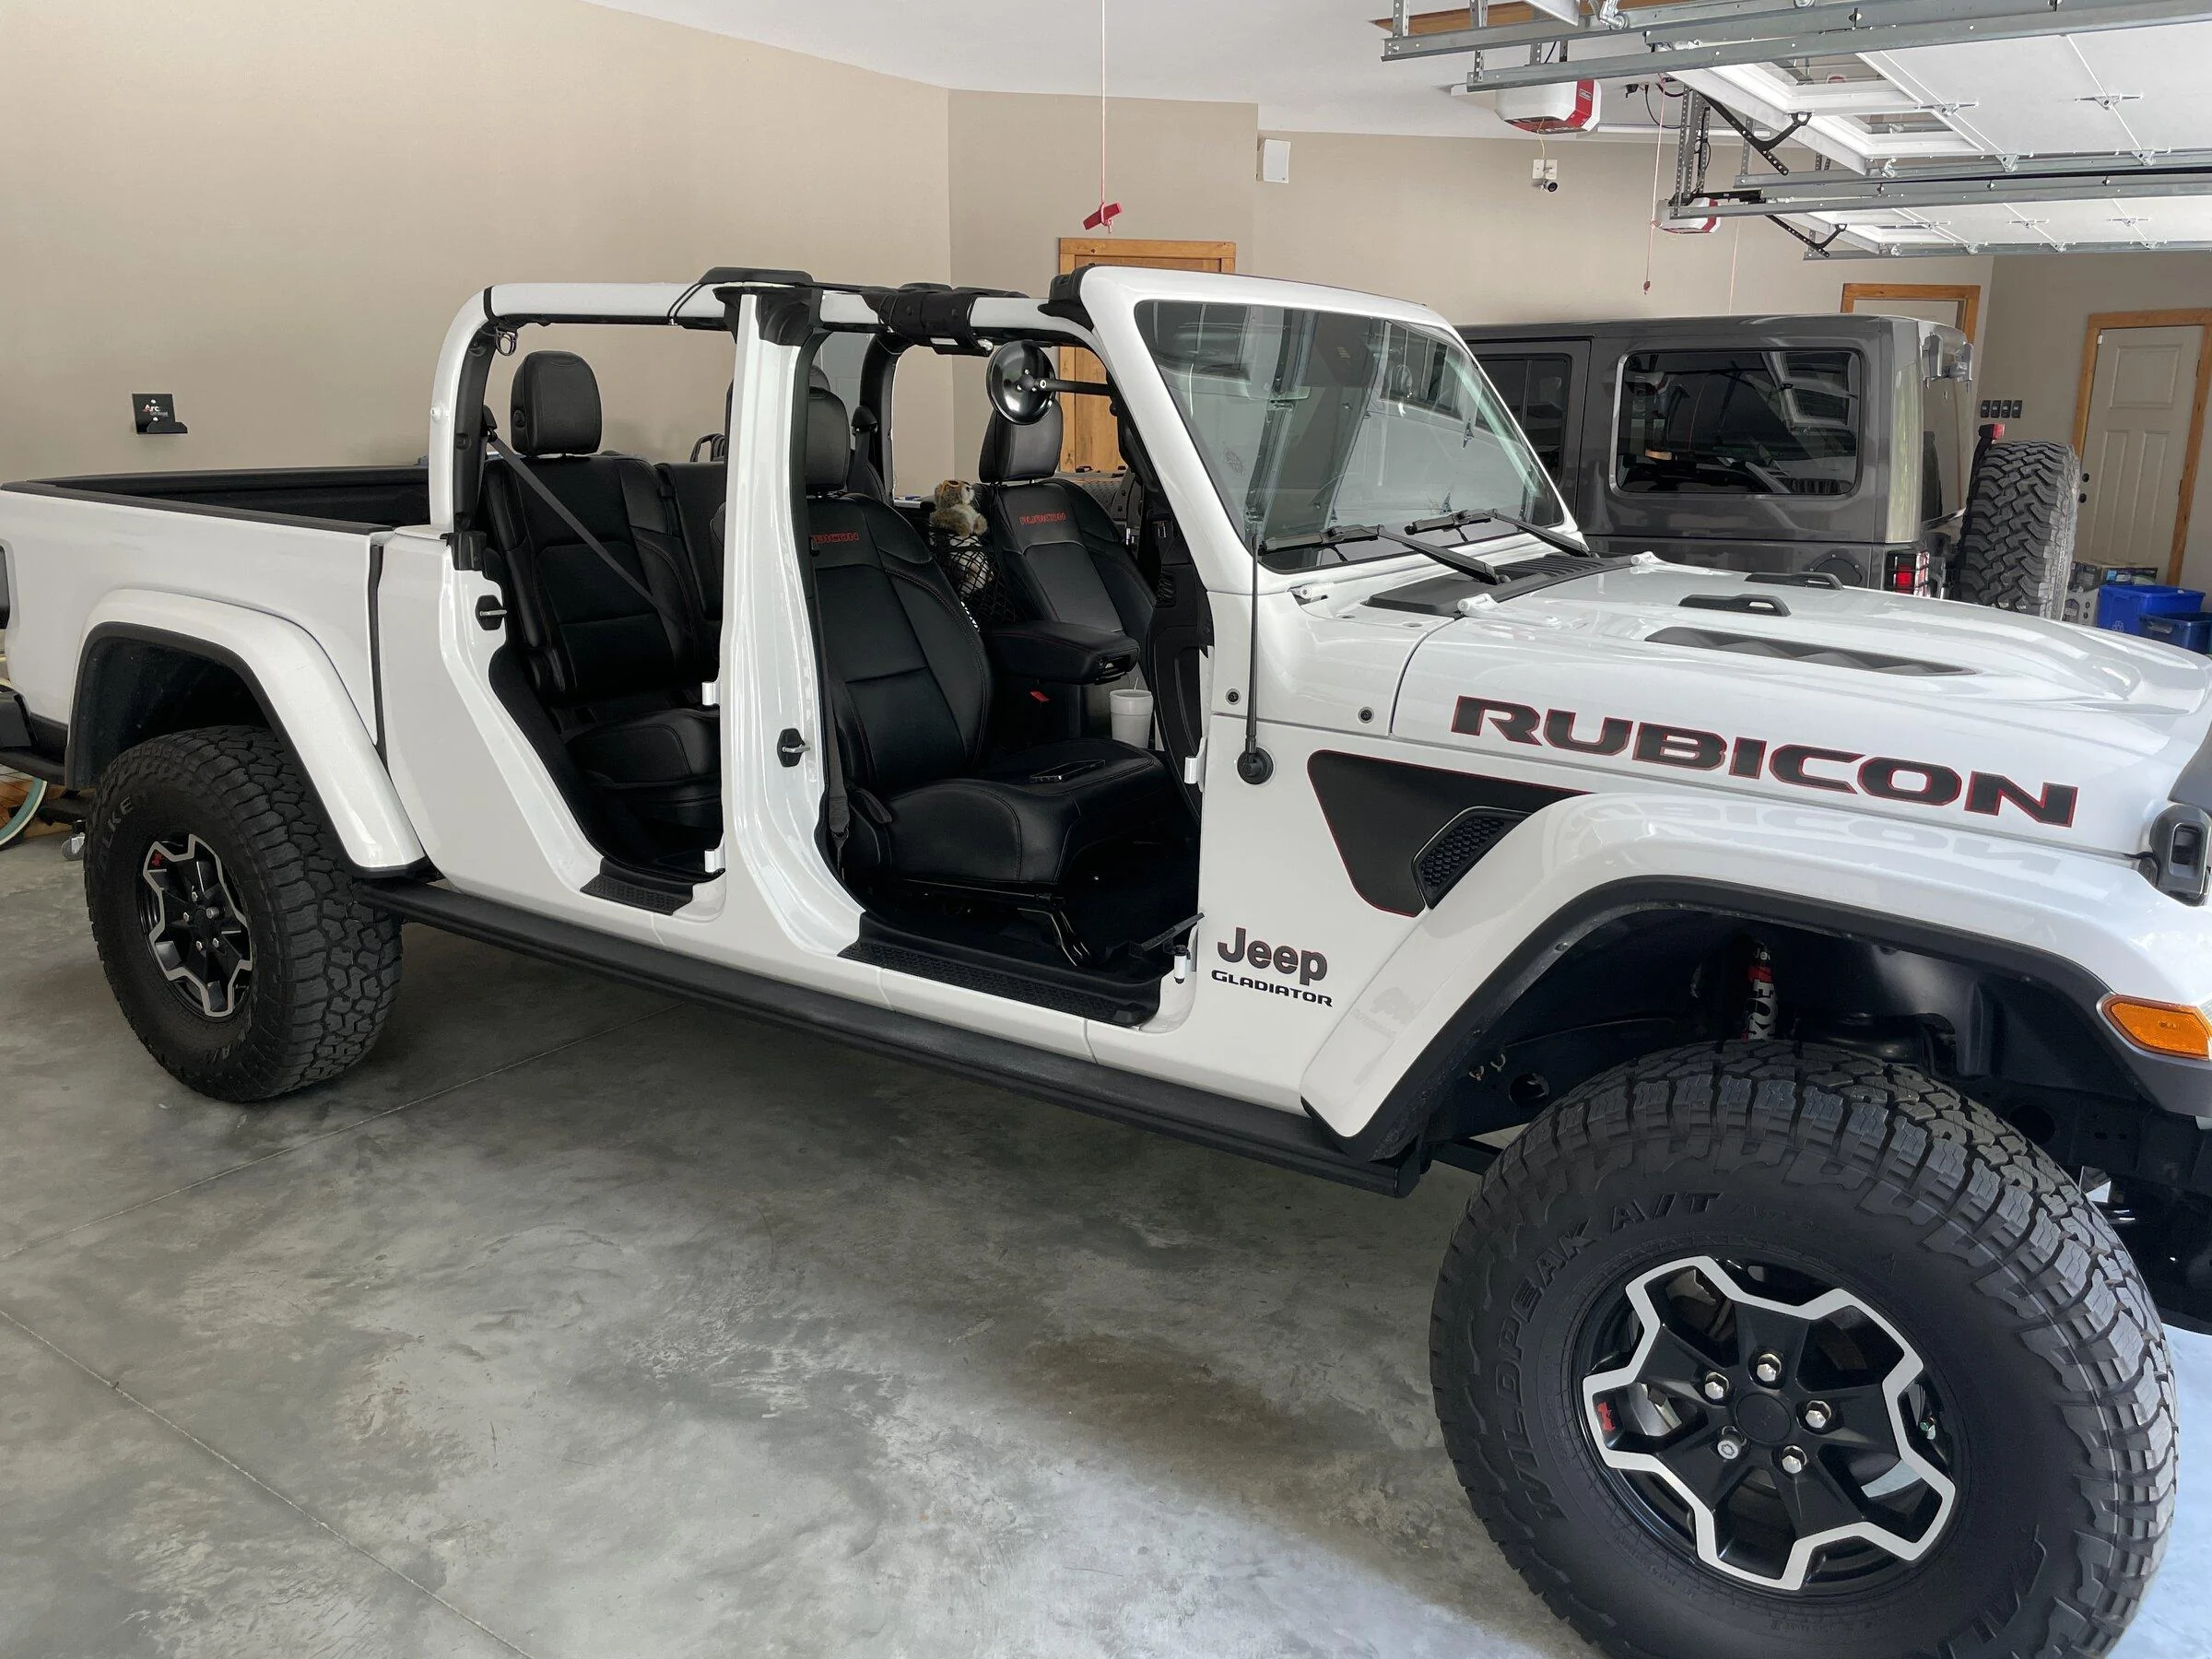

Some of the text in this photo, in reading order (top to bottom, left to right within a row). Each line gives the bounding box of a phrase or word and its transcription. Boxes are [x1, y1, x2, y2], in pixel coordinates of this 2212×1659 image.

[1451, 695, 2078, 828] RUBICON
[1217, 926, 1328, 986] Jeep
[1211, 970, 1333, 1007] GLADIATOR
